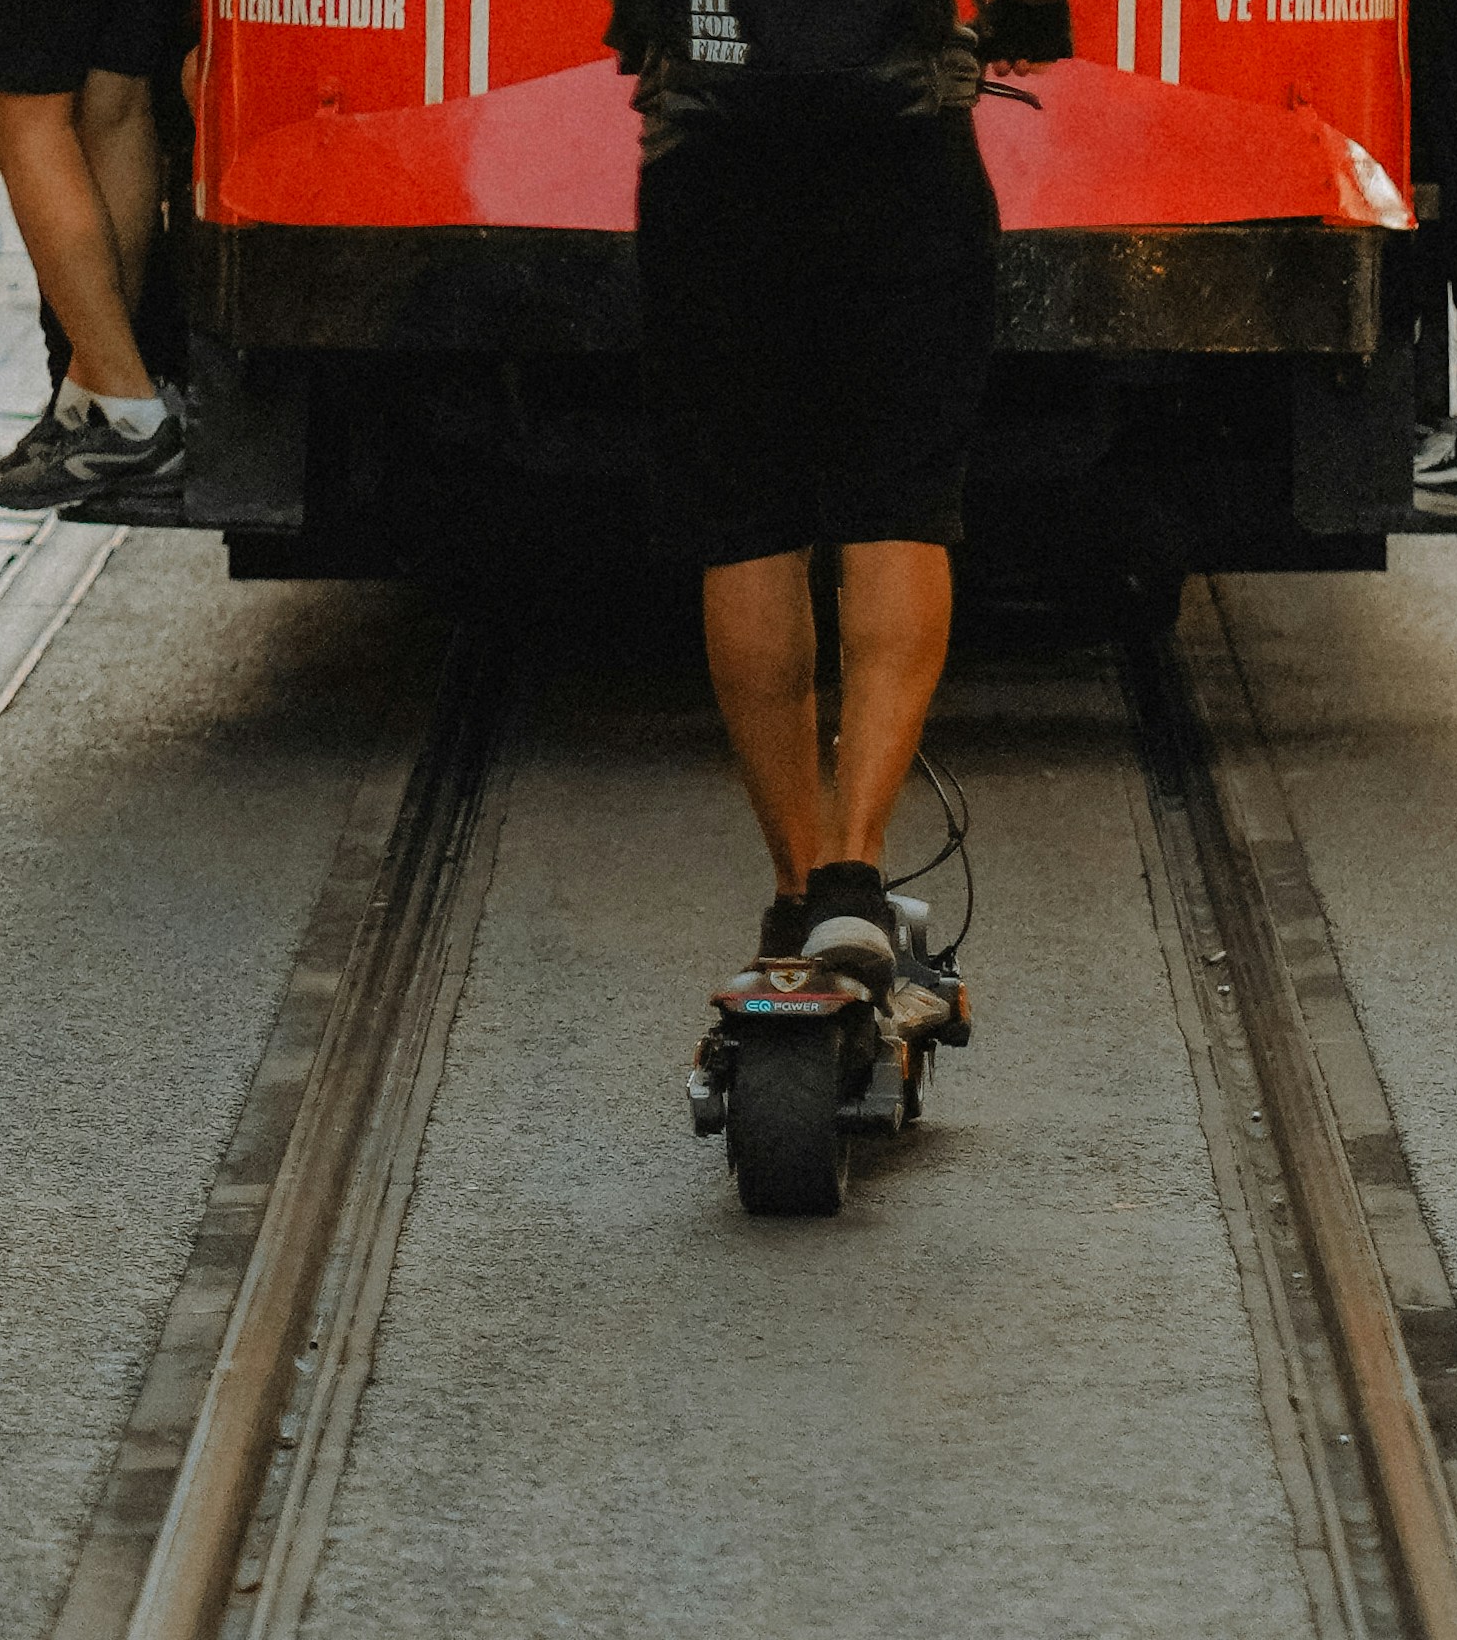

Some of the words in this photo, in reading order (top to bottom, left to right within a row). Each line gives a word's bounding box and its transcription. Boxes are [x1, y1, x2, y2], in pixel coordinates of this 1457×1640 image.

[691, 14, 739, 39] FOR
[691, 39, 748, 65] FREE
[745, 1000, 772, 1012] EQ
[774, 1002, 819, 1012] POWER
